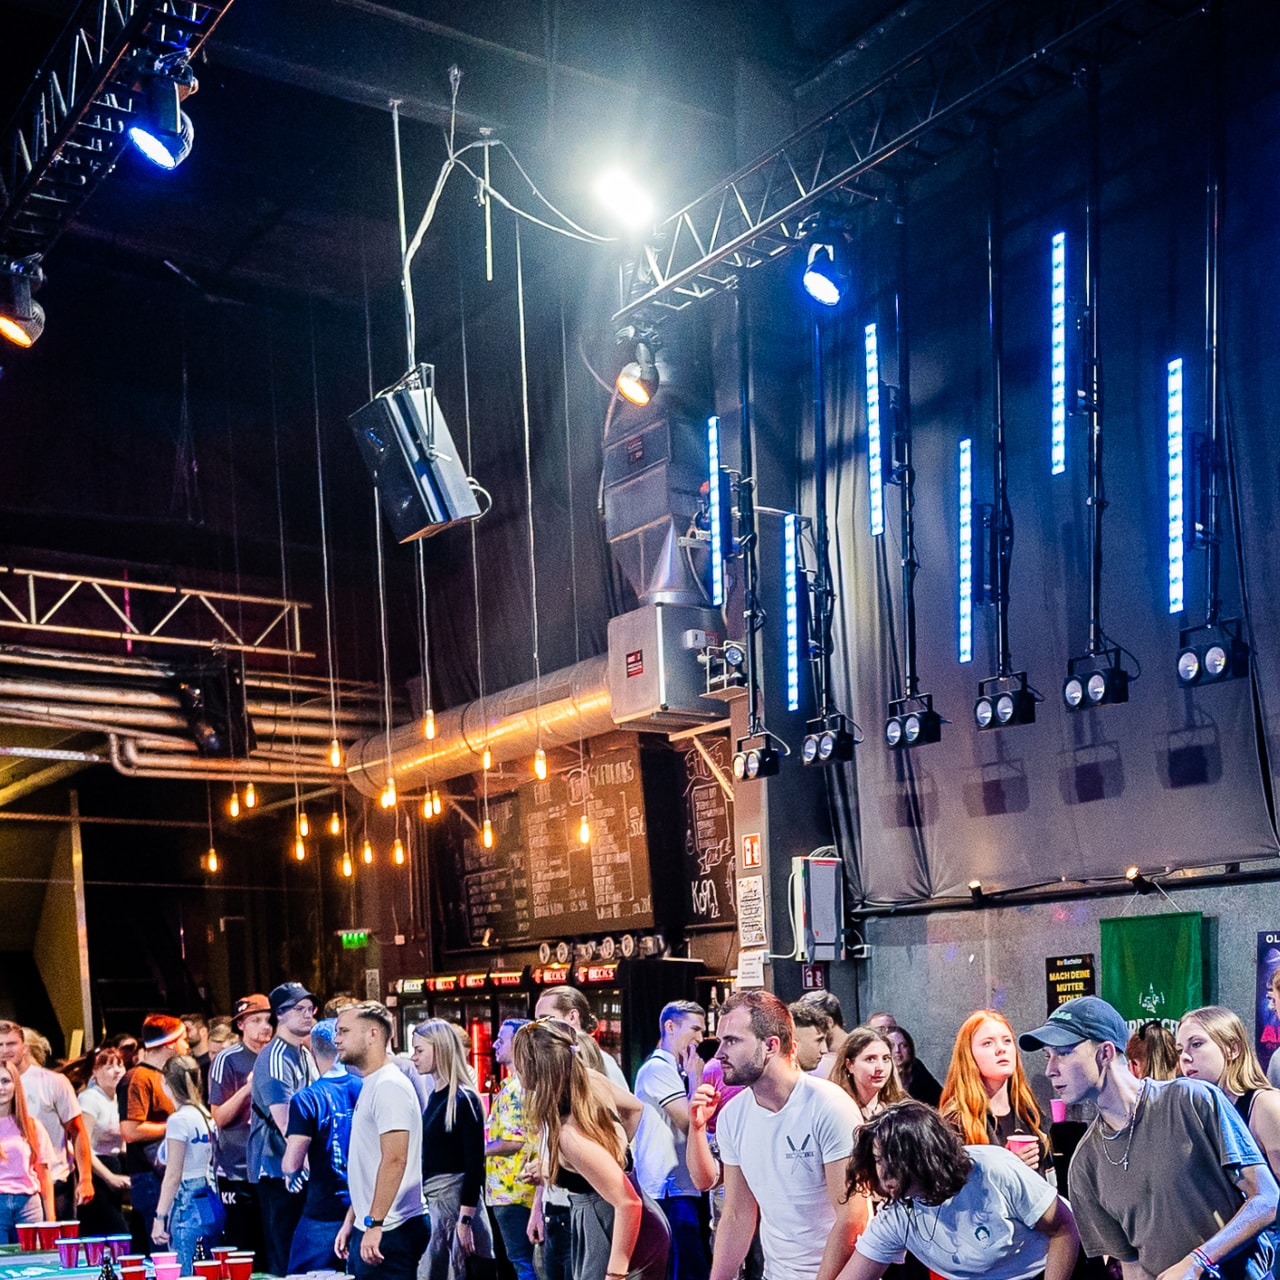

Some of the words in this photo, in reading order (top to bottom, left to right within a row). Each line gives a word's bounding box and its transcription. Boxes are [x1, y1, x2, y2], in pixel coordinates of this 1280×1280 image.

[1049, 971, 1070, 981] MACH
[1070, 969, 1090, 979] DEINE
[1056, 982, 1084, 992] MUTTER
